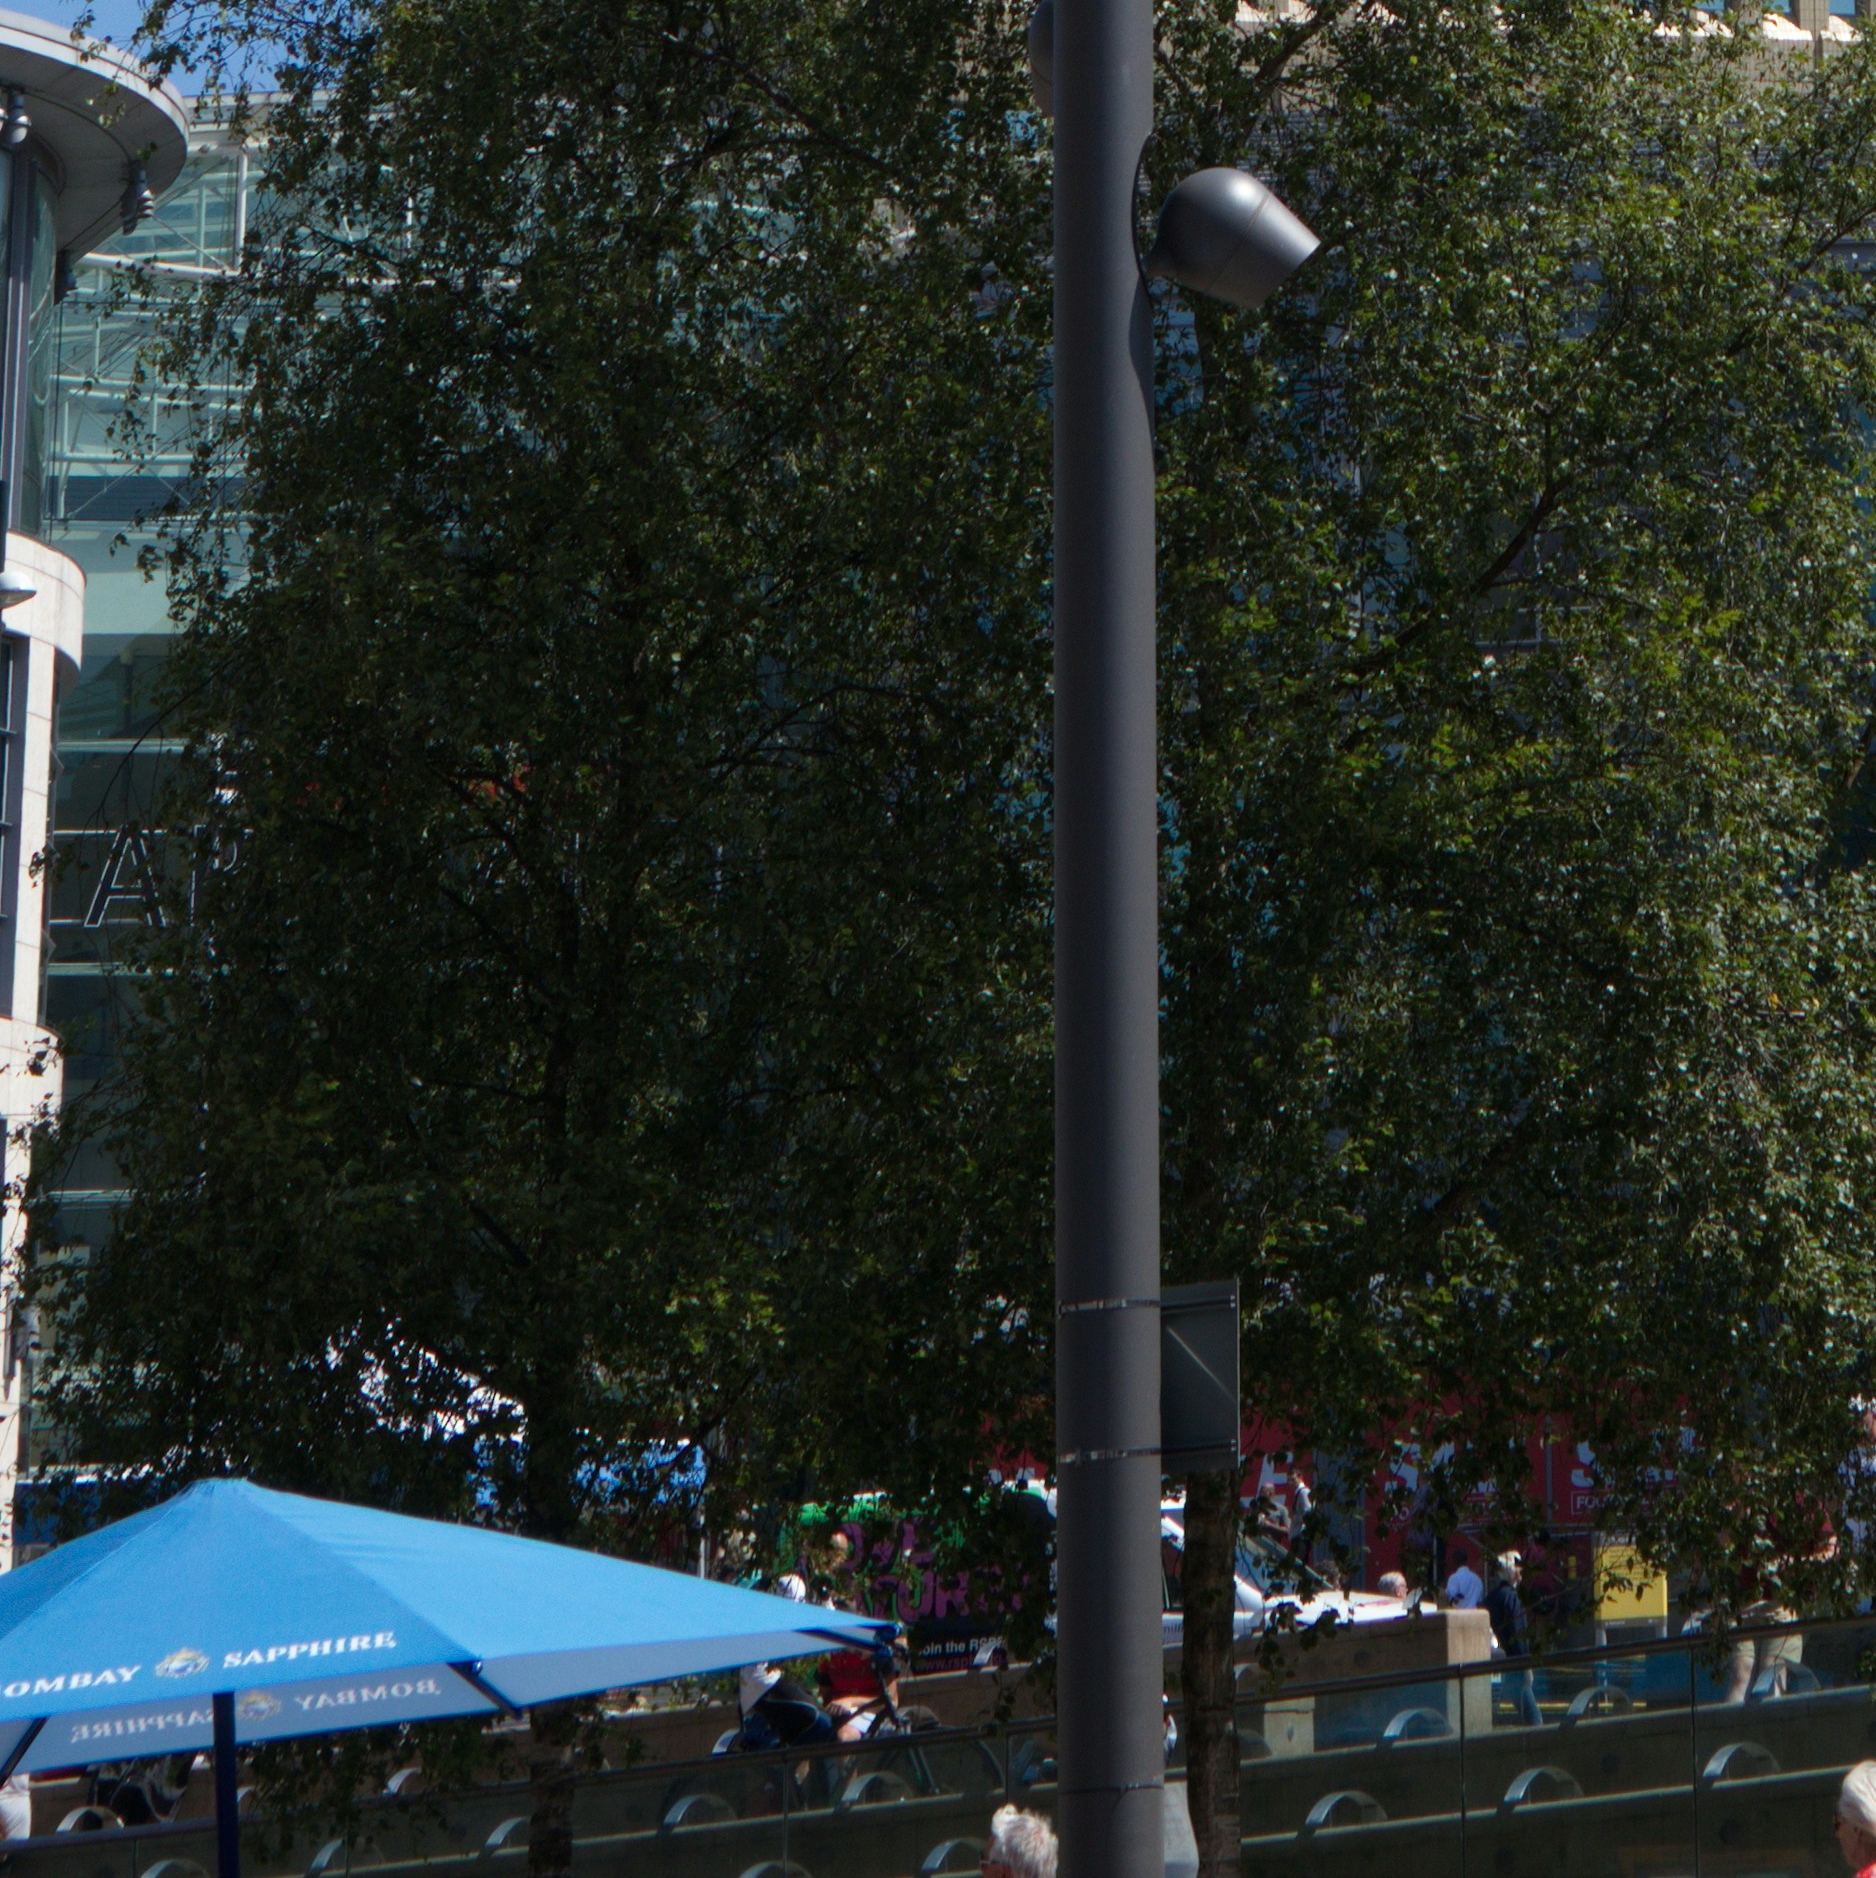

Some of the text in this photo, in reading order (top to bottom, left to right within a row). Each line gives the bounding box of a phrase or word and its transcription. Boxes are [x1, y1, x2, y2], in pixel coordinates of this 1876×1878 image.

[0, 1631, 397, 1697] OMBAY SAPPHIRE
[918, 1641, 942, 1657] oin
[945, 1640, 966, 1653] the
